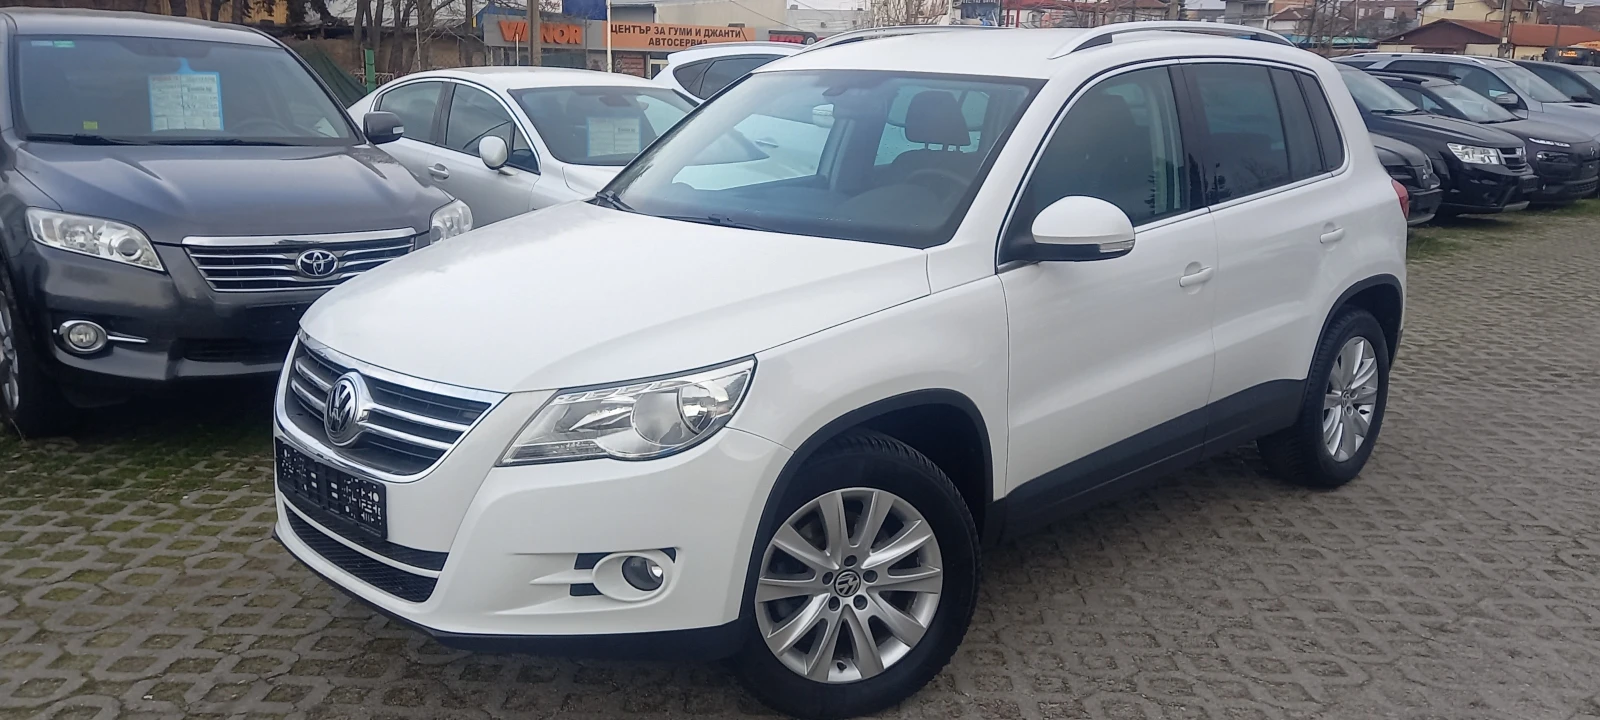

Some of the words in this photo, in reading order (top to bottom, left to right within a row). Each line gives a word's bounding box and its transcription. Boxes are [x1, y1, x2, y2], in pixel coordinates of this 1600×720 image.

[611, 24, 651, 34] ЦЕНТЪР
[654, 26, 666, 35] ЗА
[668, 27, 693, 36] ГУМИ
[695, 28, 702, 37] И
[704, 29, 741, 38] ДЖАНТИ
